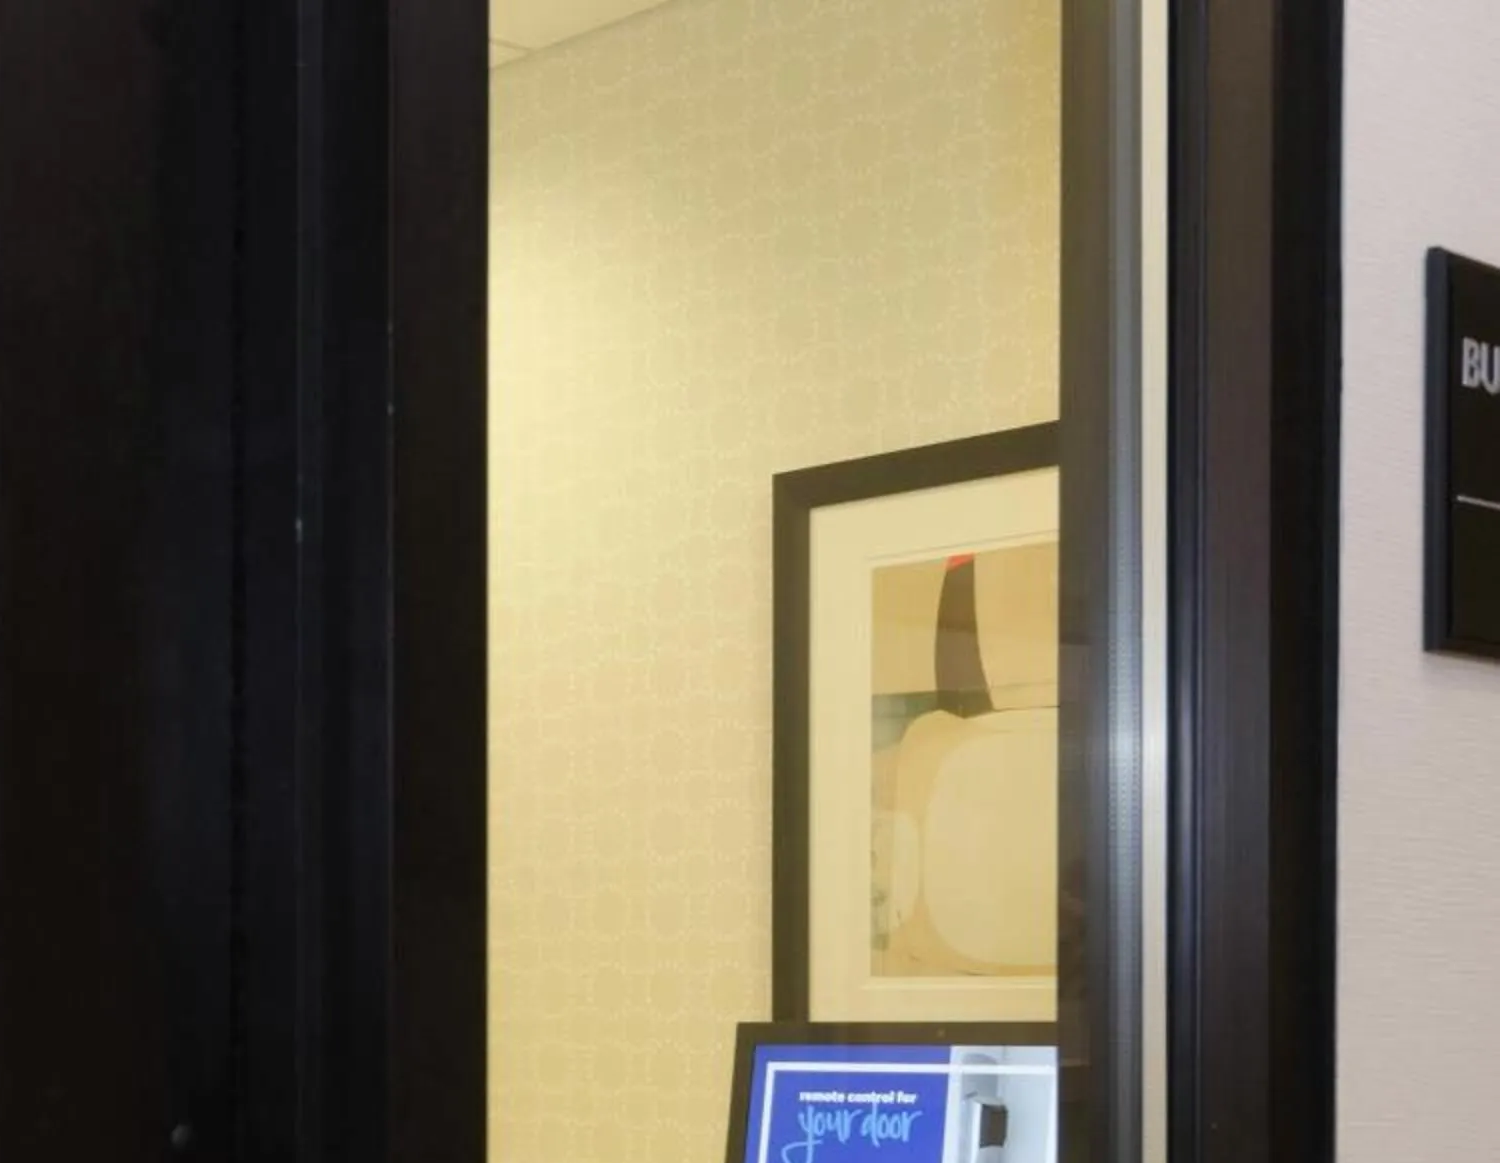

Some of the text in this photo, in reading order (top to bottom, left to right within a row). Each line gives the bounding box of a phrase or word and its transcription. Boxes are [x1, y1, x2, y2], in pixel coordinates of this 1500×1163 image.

[1462, 336, 1500, 395] BU
[799, 1089, 918, 1105] remote control for
[860, 1099, 924, 1148] door
